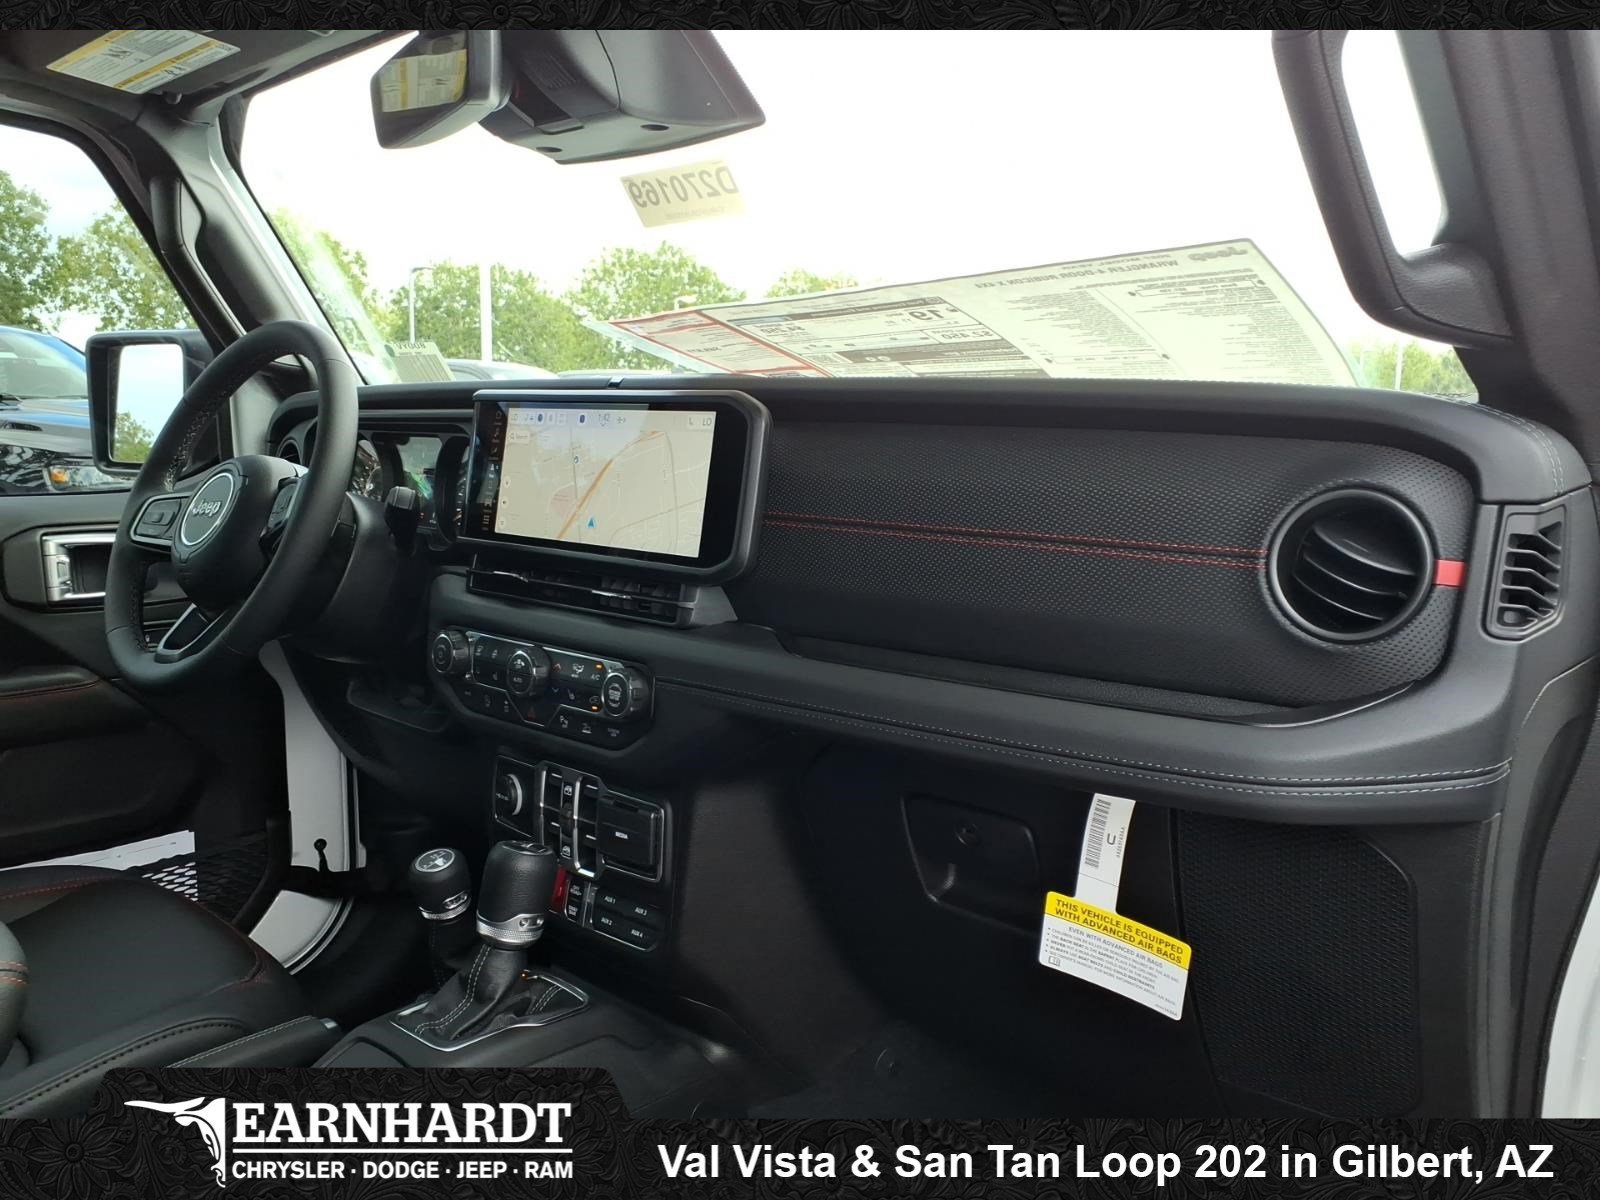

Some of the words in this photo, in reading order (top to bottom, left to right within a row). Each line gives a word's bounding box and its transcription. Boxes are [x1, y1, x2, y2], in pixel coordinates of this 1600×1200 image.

[192, 499, 221, 517] Jeep
[1107, 833, 1116, 845] U
[1056, 899, 1079, 912] THIS
[1081, 907, 1124, 928] VEHICLE
[1123, 923, 1133, 933] IS
[1135, 928, 1184, 954] EQUIPPED
[1056, 908, 1080, 923] WITH
[1083, 918, 1136, 943] ADVANCED
[1138, 940, 1154, 951] AIR
[1156, 948, 1183, 964] BAGS
[1068, 926, 1084, 936] EVEN
[1086, 933, 1102, 942] WITH
[1103, 939, 1135, 955] ADVANCED
[1136, 952, 1146, 960] AIR
[1147, 957, 1163, 968] BAGS
